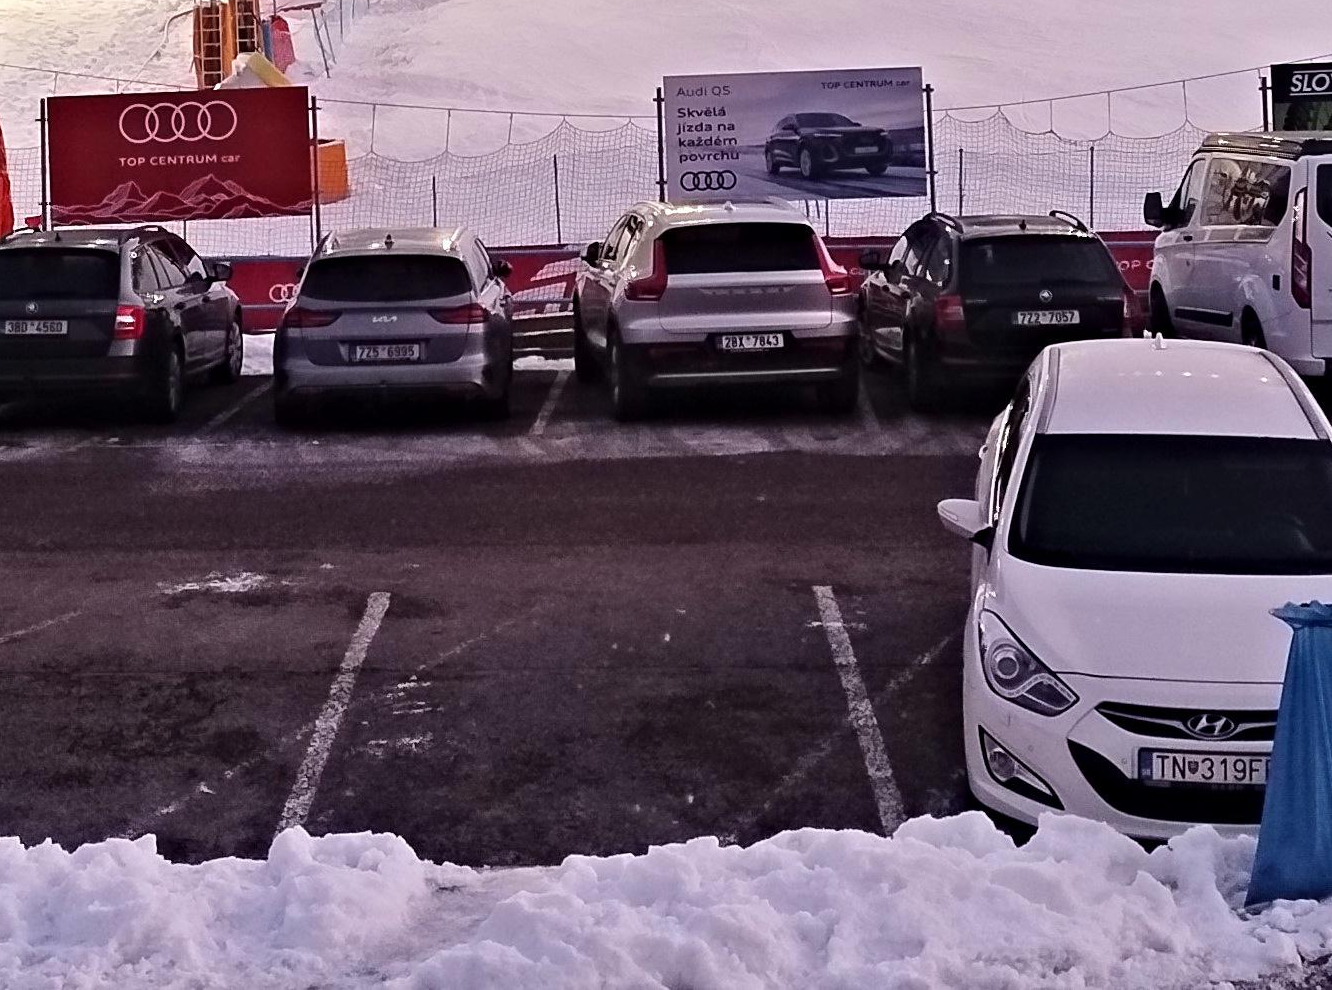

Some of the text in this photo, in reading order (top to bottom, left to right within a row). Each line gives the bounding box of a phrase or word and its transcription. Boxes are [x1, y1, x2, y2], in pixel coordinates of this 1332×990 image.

[676, 85, 731, 97] Audi Q5
[821, 81, 840, 90] TOP
[843, 80, 893, 89] CENTRUM
[677, 106, 726, 118] Skvělá
[676, 122, 735, 136] jízda na
[678, 136, 738, 148] každém
[119, 154, 241, 167] TOP CENTRUM car
[679, 151, 740, 164] povrchu
[1156, 755, 1186, 779] TN
